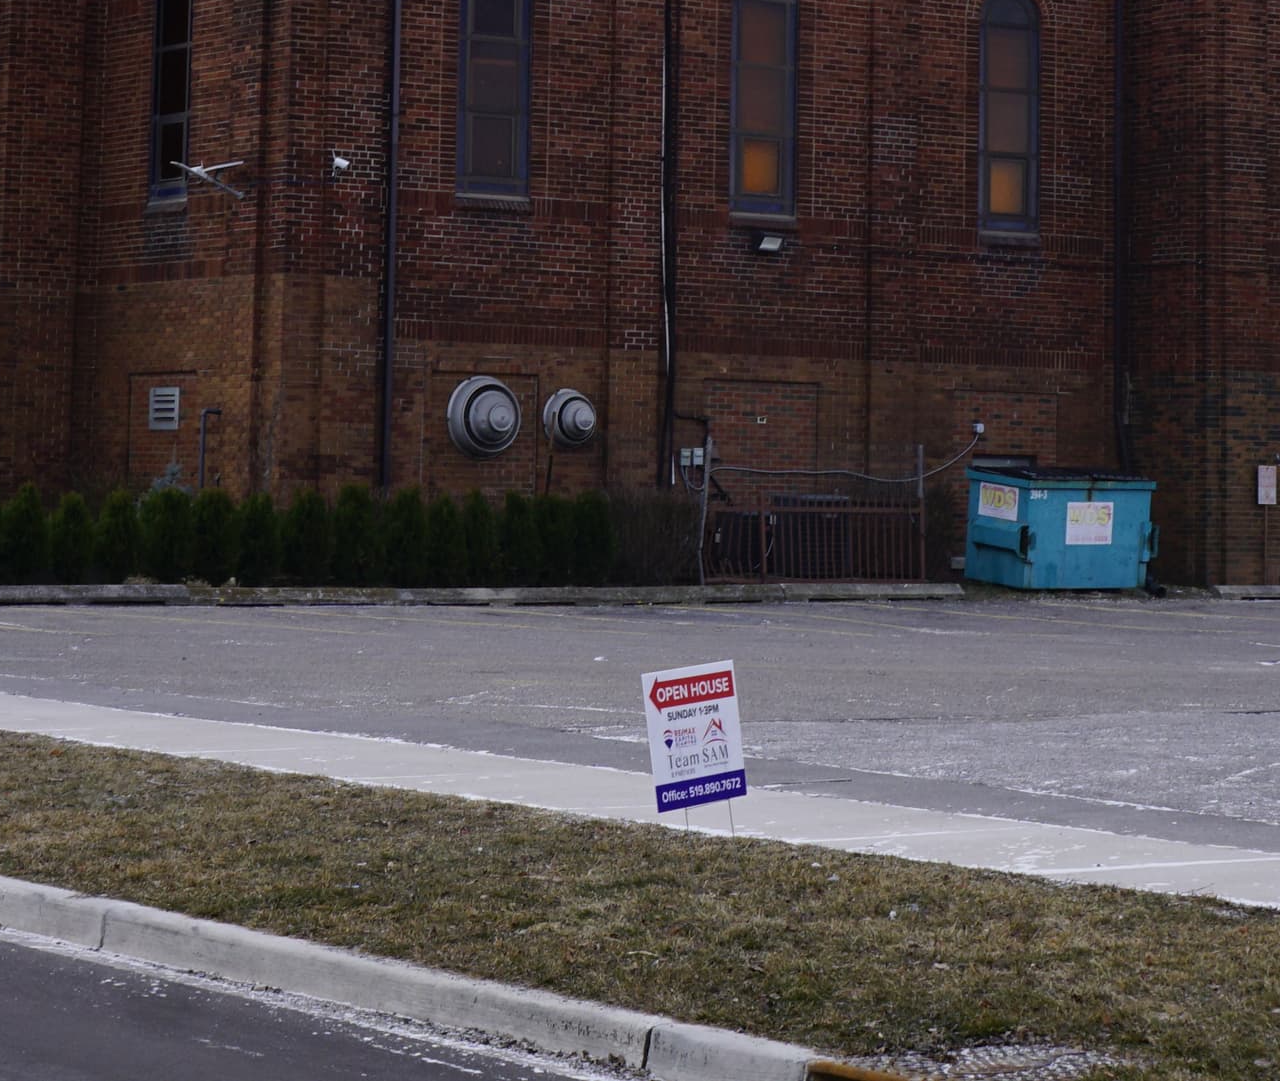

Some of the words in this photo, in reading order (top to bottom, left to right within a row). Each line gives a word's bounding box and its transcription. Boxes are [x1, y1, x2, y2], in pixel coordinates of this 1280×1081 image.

[982, 485, 1017, 511] WDS
[656, 684, 689, 703] OPEN
[690, 677, 730, 698] HOUSE
[667, 708, 697, 722] SUNDAY
[667, 752, 700, 770] Team
[702, 744, 729, 763] SAM
[661, 788, 689, 804] Office:
[688, 777, 742, 799] 519.890.7672
